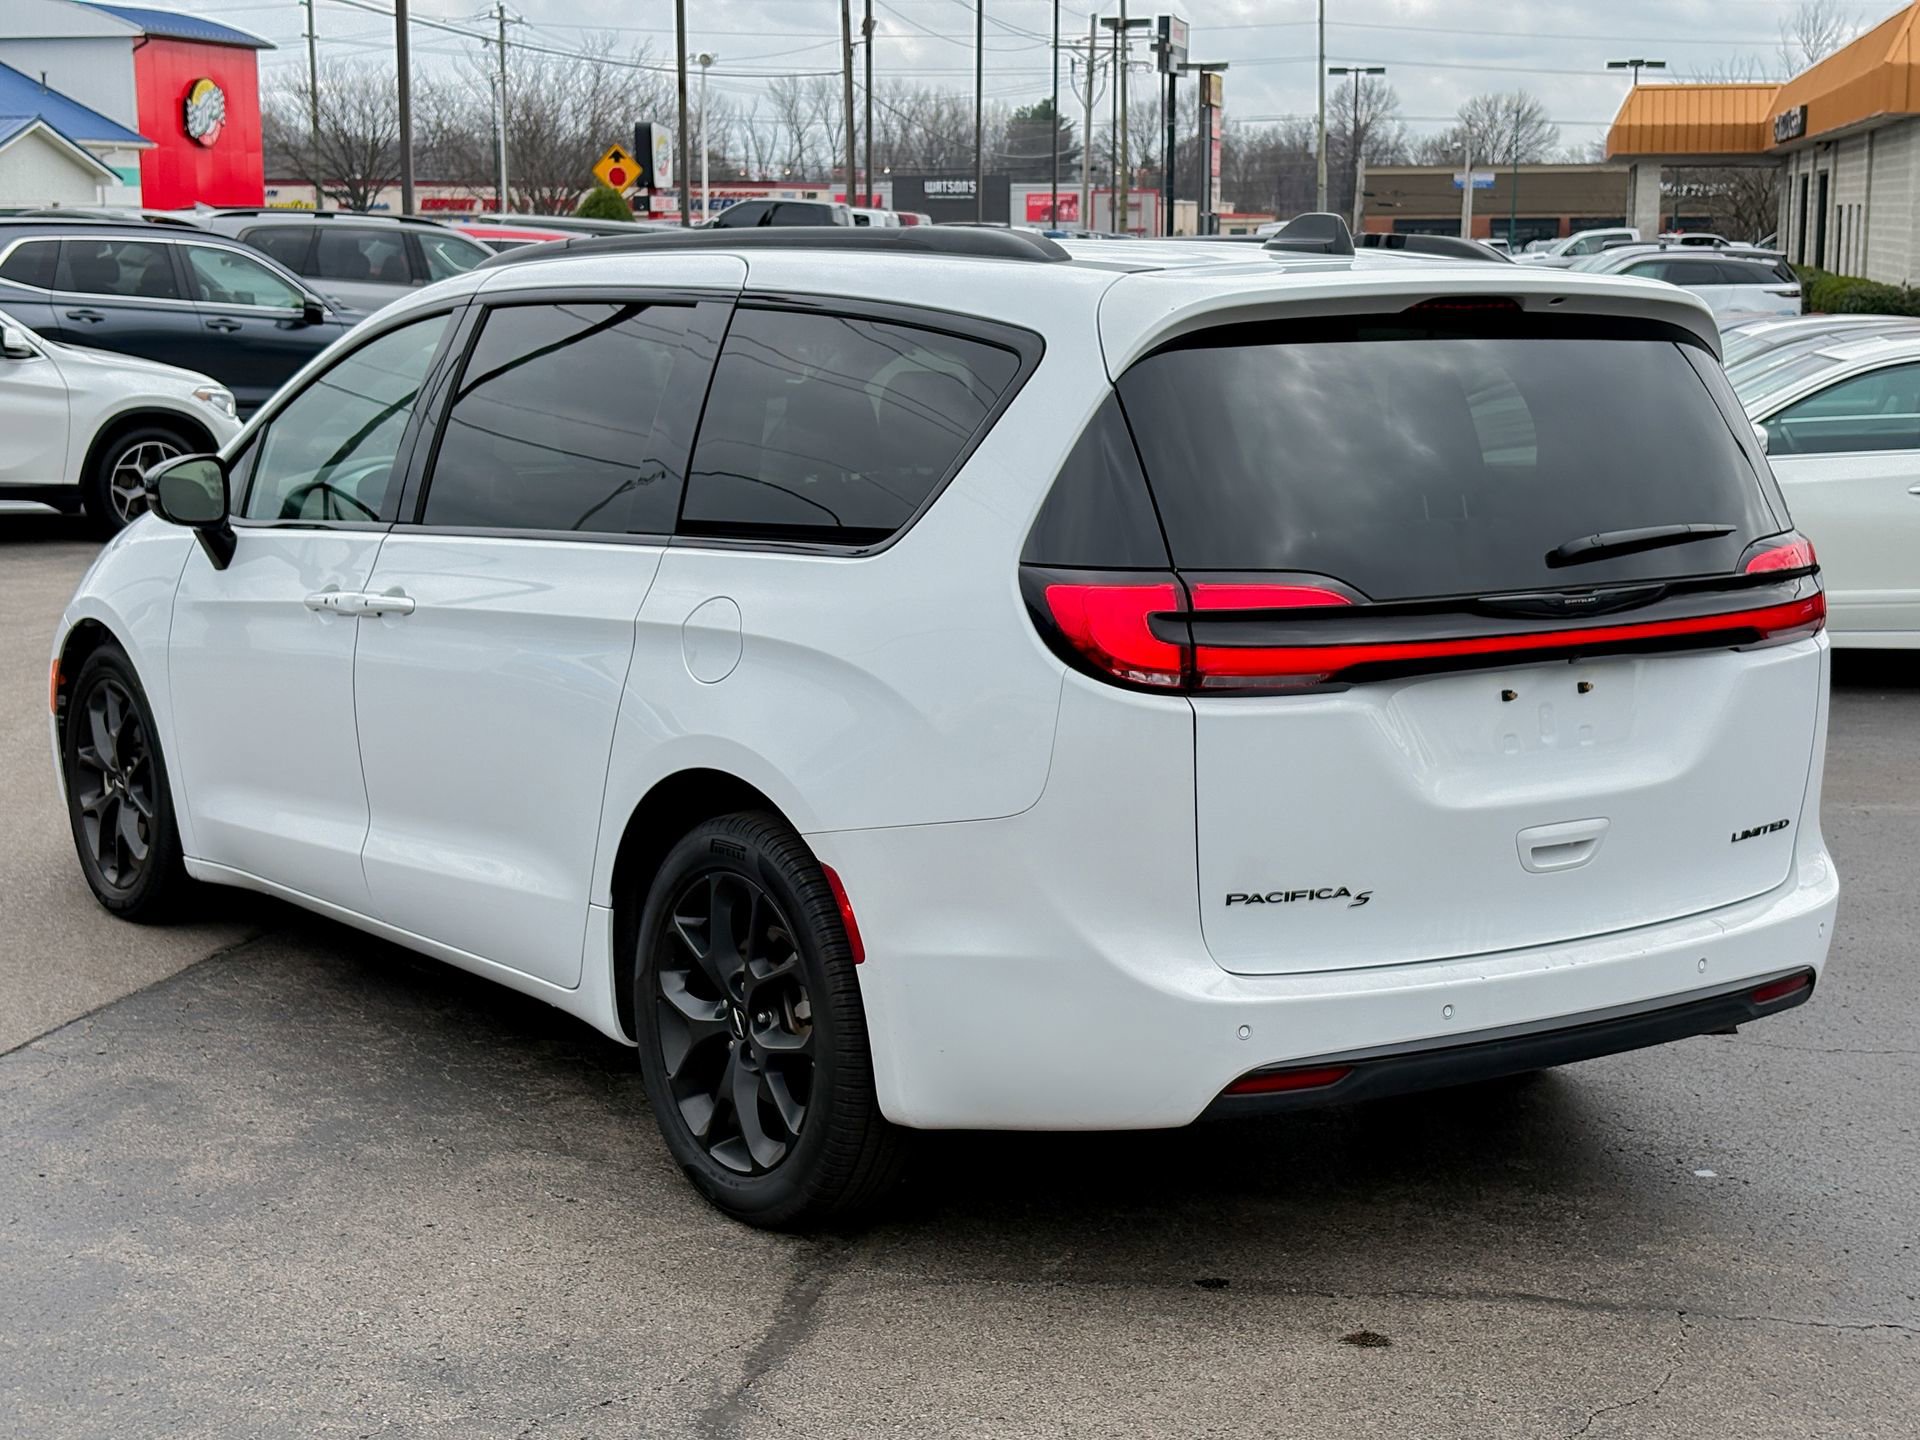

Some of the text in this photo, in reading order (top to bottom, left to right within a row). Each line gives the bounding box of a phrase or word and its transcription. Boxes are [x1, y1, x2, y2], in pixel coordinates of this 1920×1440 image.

[1731, 818, 1790, 843] LIMITED
[1225, 886, 1374, 909] PACIFICA S
